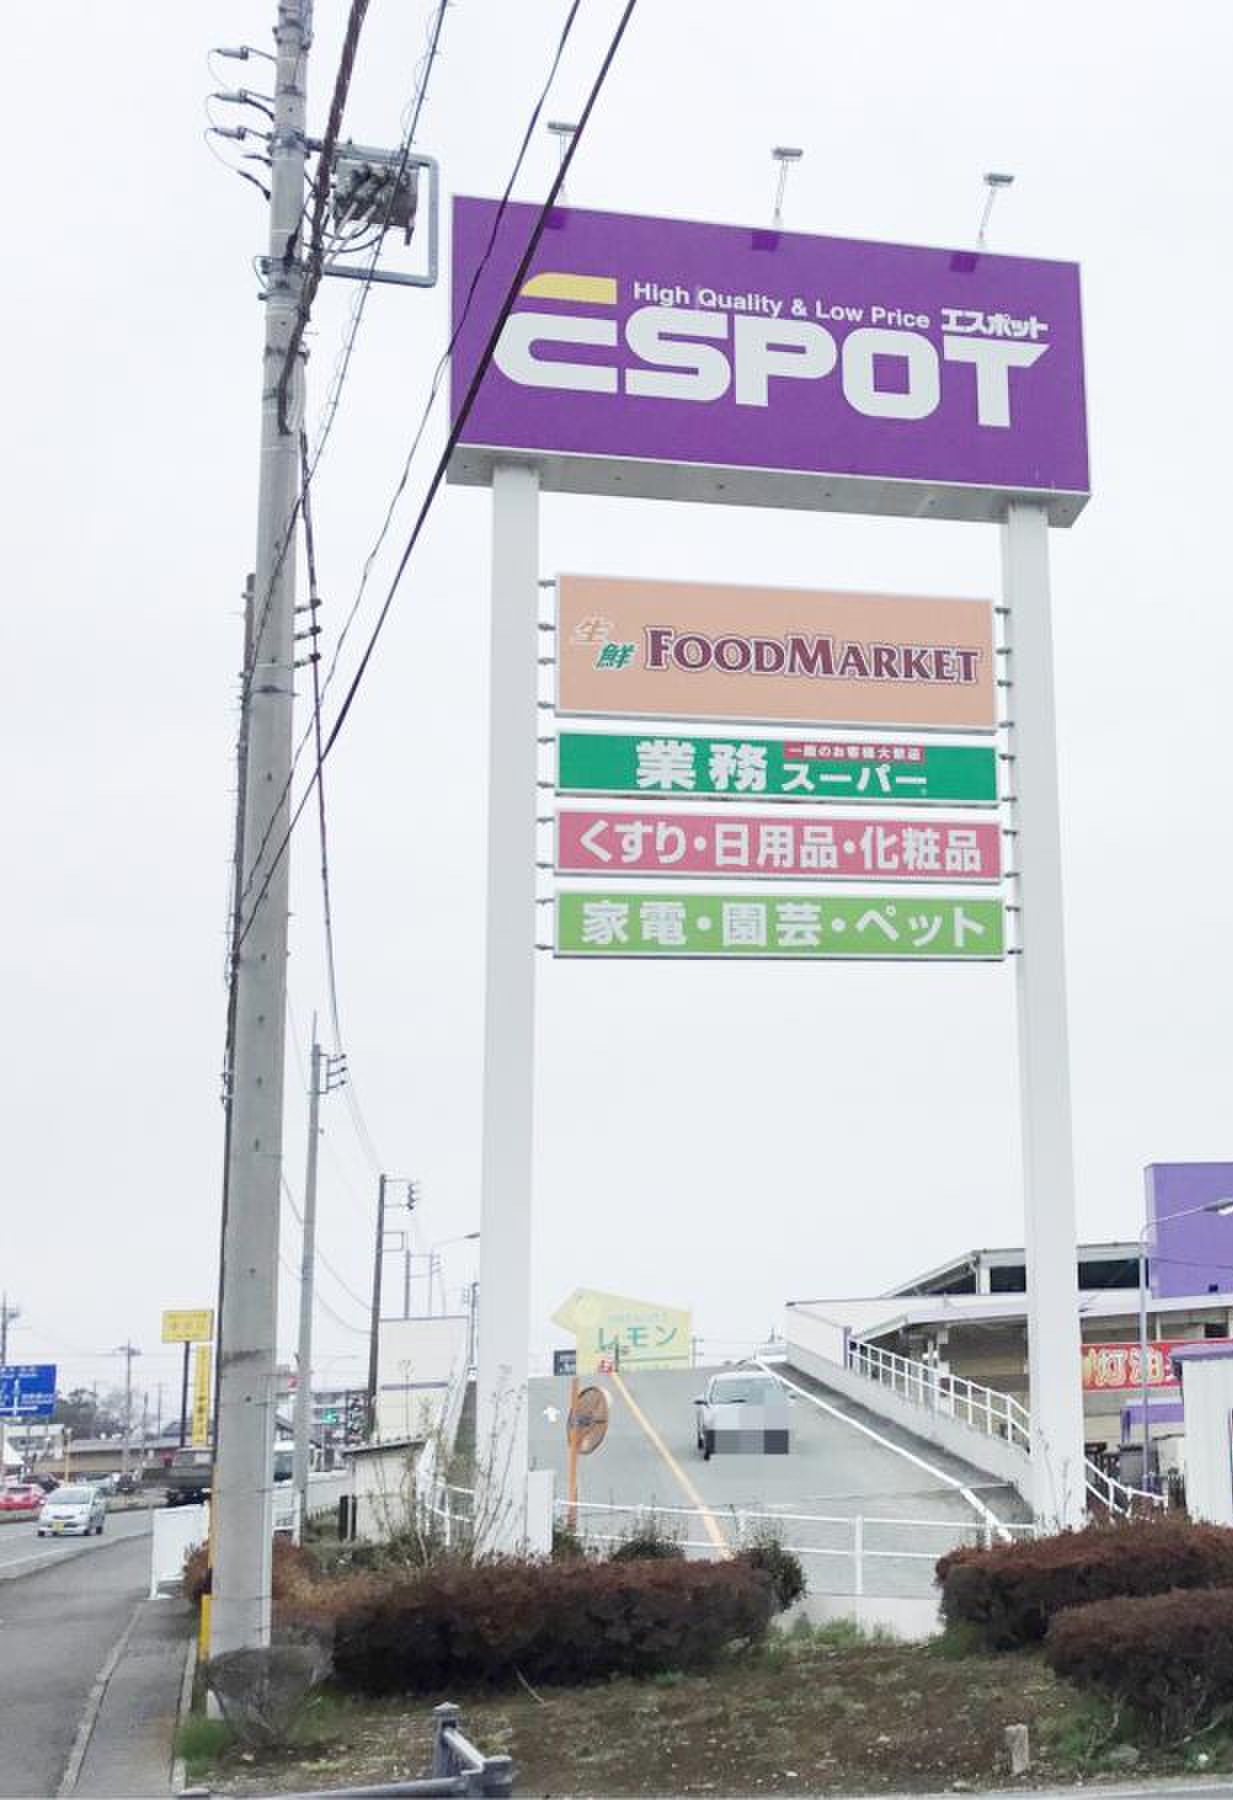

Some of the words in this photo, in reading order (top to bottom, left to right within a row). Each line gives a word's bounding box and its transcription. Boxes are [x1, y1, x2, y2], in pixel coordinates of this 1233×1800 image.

[633, 280, 691, 307] High
[697, 287, 783, 319] Quality
[790, 299, 808, 318] &
[815, 300, 865, 323] Low
[871, 305, 931, 330] Price
[941, 308, 1050, 340] エスポット
[493, 271, 1051, 429] ESPOT
